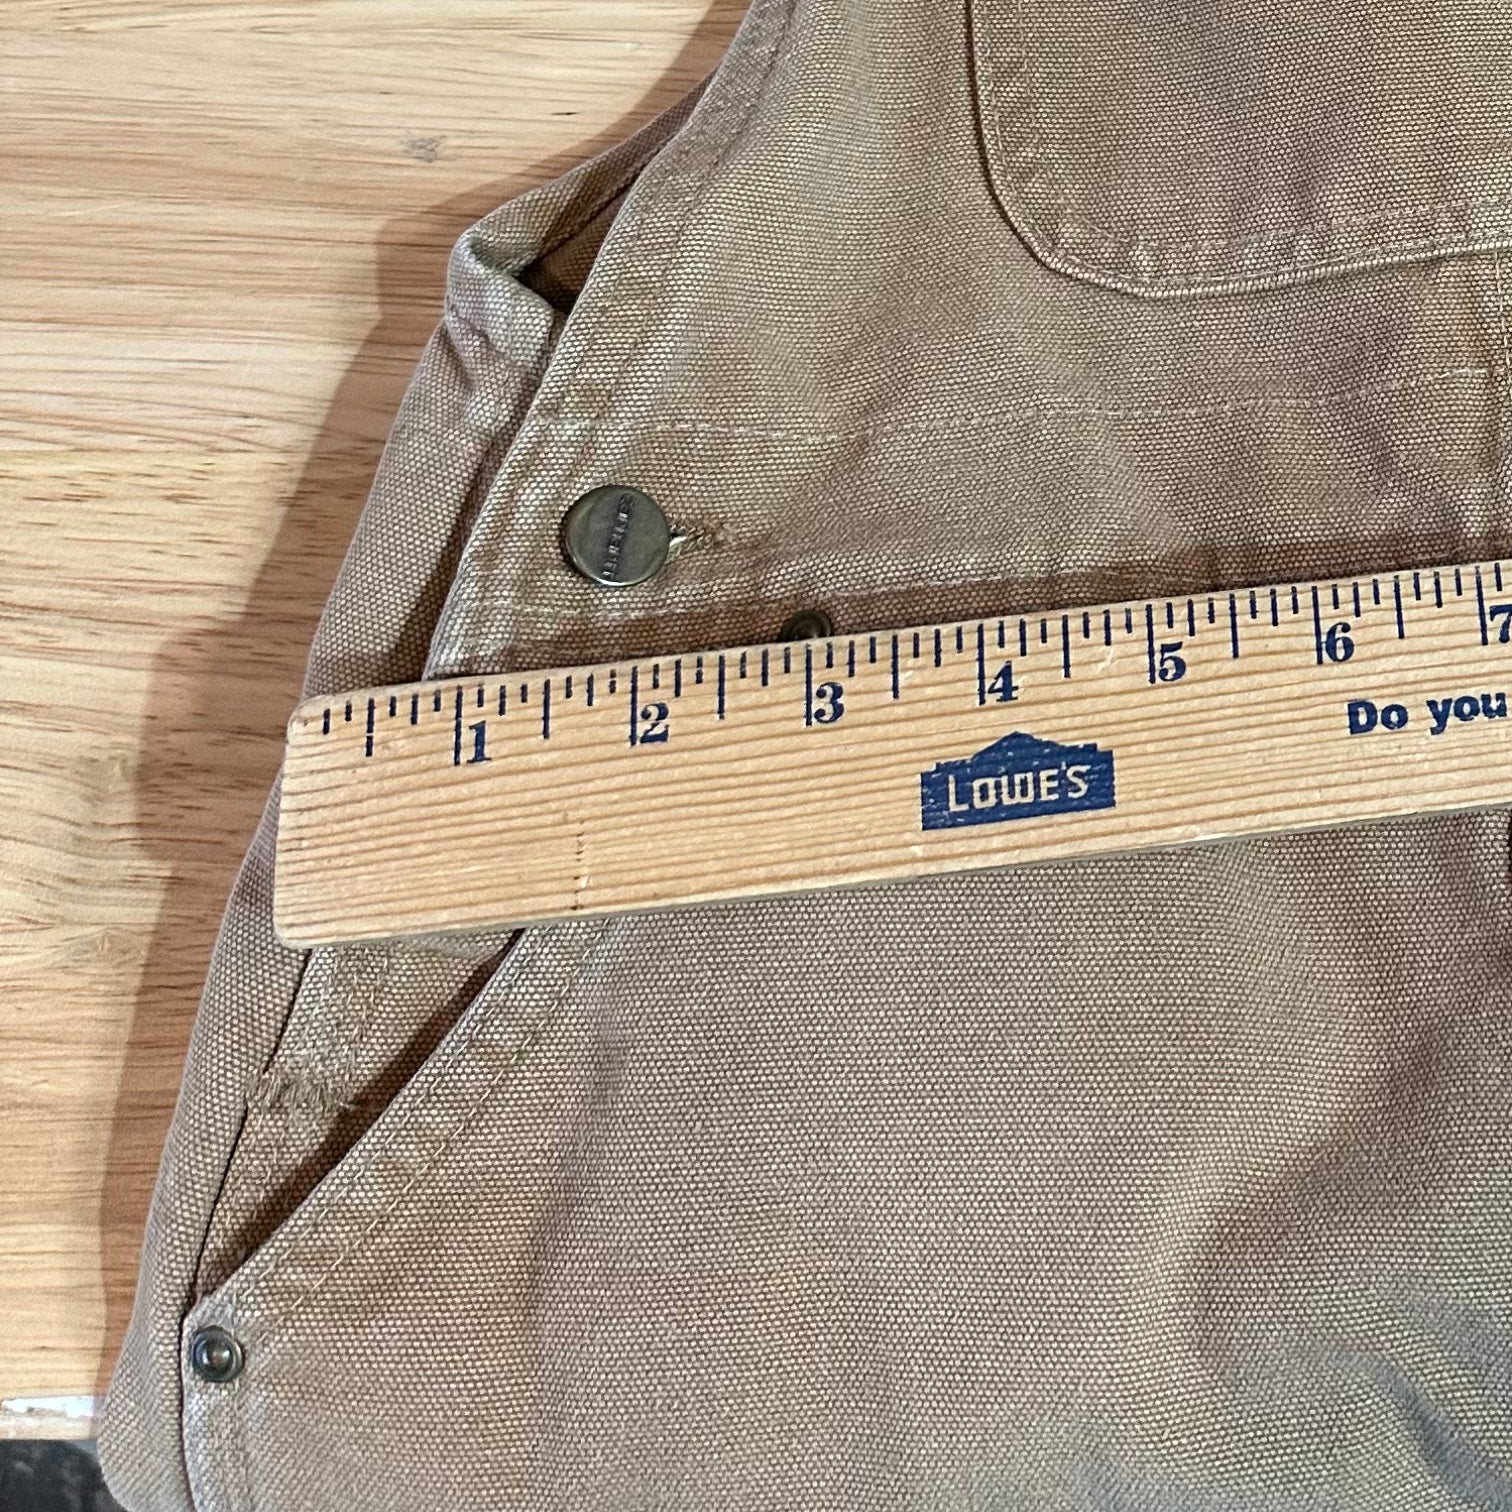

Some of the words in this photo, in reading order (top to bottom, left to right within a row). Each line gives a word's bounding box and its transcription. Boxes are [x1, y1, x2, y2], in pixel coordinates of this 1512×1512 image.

[466, 719, 492, 764] 1
[640, 702, 670, 745] 2
[814, 681, 845, 724] 3
[987, 660, 1020, 703] 4
[1158, 642, 1188, 682] 5
[1325, 622, 1356, 664] 6
[1347, 698, 1409, 735] Do
[1426, 692, 1507, 735] you
[947, 763, 1092, 812] LOWE'S
